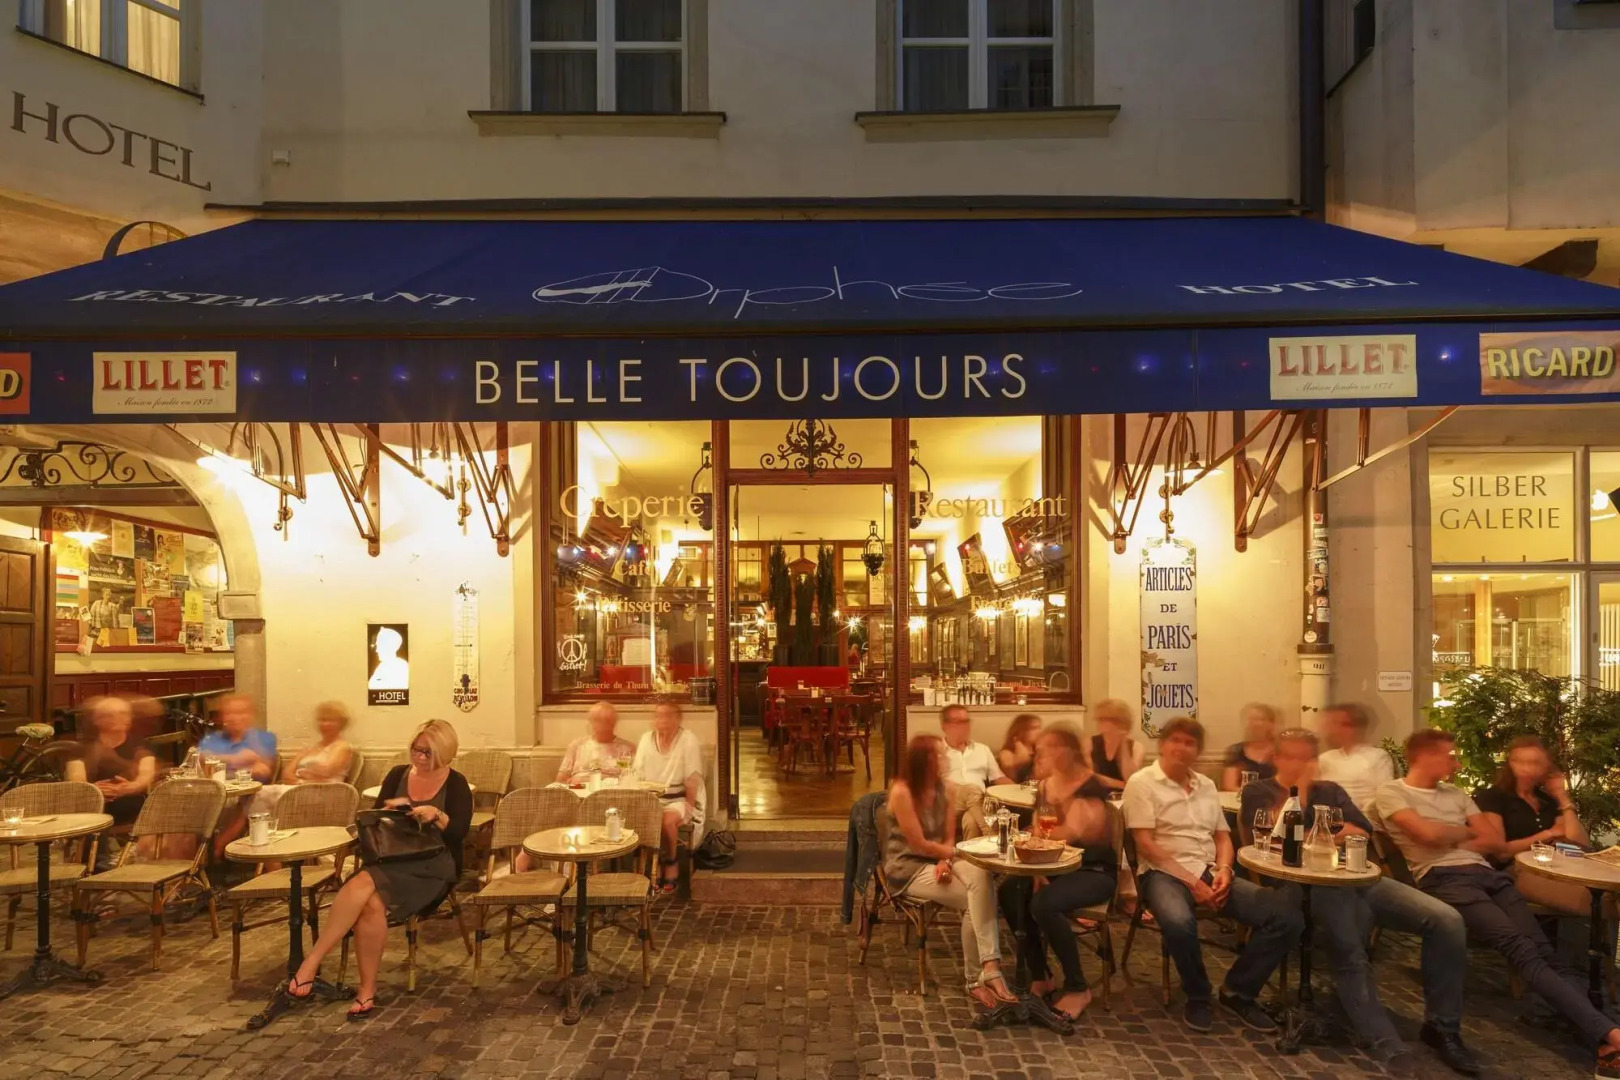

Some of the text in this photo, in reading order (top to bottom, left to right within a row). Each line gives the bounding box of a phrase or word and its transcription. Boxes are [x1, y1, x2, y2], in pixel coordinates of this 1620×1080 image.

[11, 91, 211, 191] HOTEL
[1177, 276, 1419, 294] HOTEL
[70, 289, 476, 307] RESTAURANT
[1277, 343, 1408, 377] LILLET
[1486, 345, 1615, 378] RICARD
[102, 359, 228, 391] LILLET
[475, 354, 1027, 404] BELLE TOUJOURS
[1452, 475, 1547, 497] SILBER
[912, 490, 1067, 519] Restaurant
[1439, 508, 1561, 529] GALERIE
[1145, 567, 1193, 591] ARTICLES
[1160, 603, 1177, 613] DE
[1147, 624, 1191, 650] PARIS
[1162, 662, 1177, 671] ET
[379, 692, 406, 700] HOTEL
[576, 681, 610, 689] Brasserie
[614, 681, 623, 689] du
[1146, 684, 1194, 708] JOUETS
